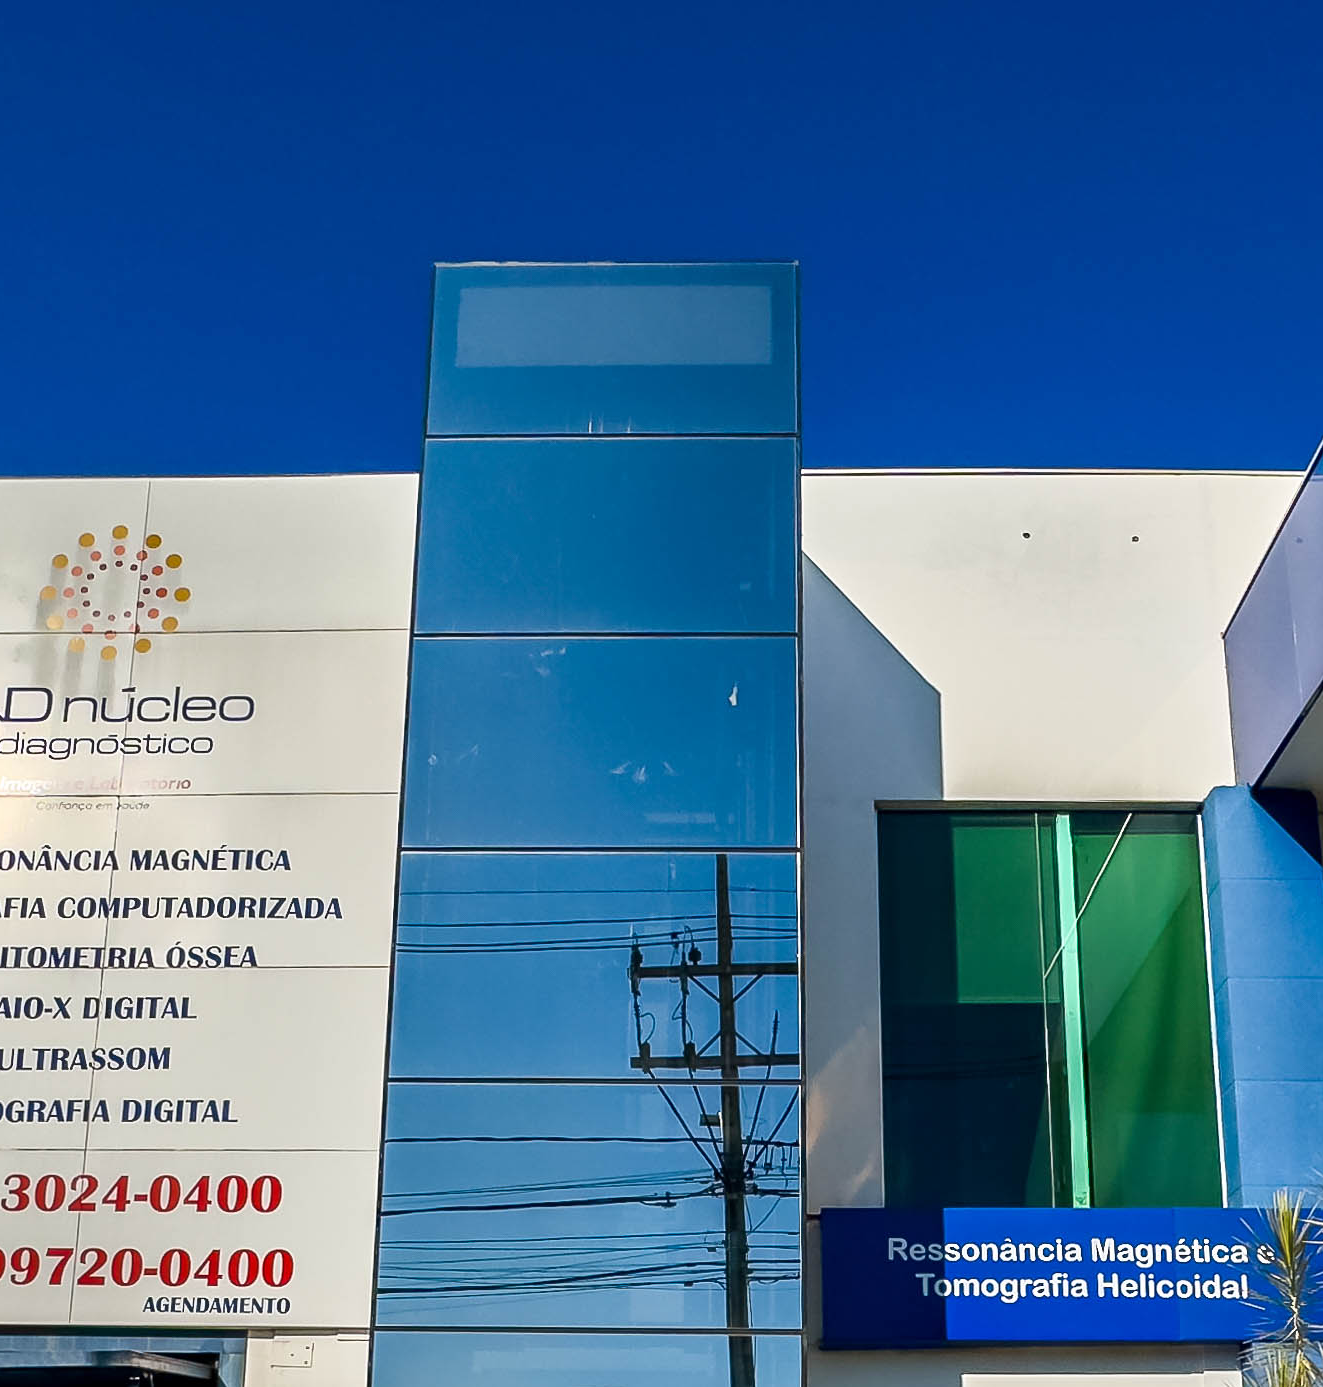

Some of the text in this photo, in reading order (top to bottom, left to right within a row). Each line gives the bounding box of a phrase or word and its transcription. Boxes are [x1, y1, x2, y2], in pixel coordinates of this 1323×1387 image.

[62, 685, 256, 723] núcleo
[129, 844, 292, 872] MAGNÉTICA
[57, 896, 343, 920] COMPUTADORIZADA
[166, 940, 258, 968] ÓSSEA
[82, 996, 197, 1020] DIGITAL
[121, 1099, 239, 1124] DIGITAL
[0, 1174, 283, 1213] 3024-0400
[888, 1237, 1082, 1264] Ressonância
[1091, 1237, 1248, 1270] Magnética
[915, 1272, 1249, 1304] Tomografia Helicoidal
[142, 1296, 291, 1315] AGENDAMENTO
